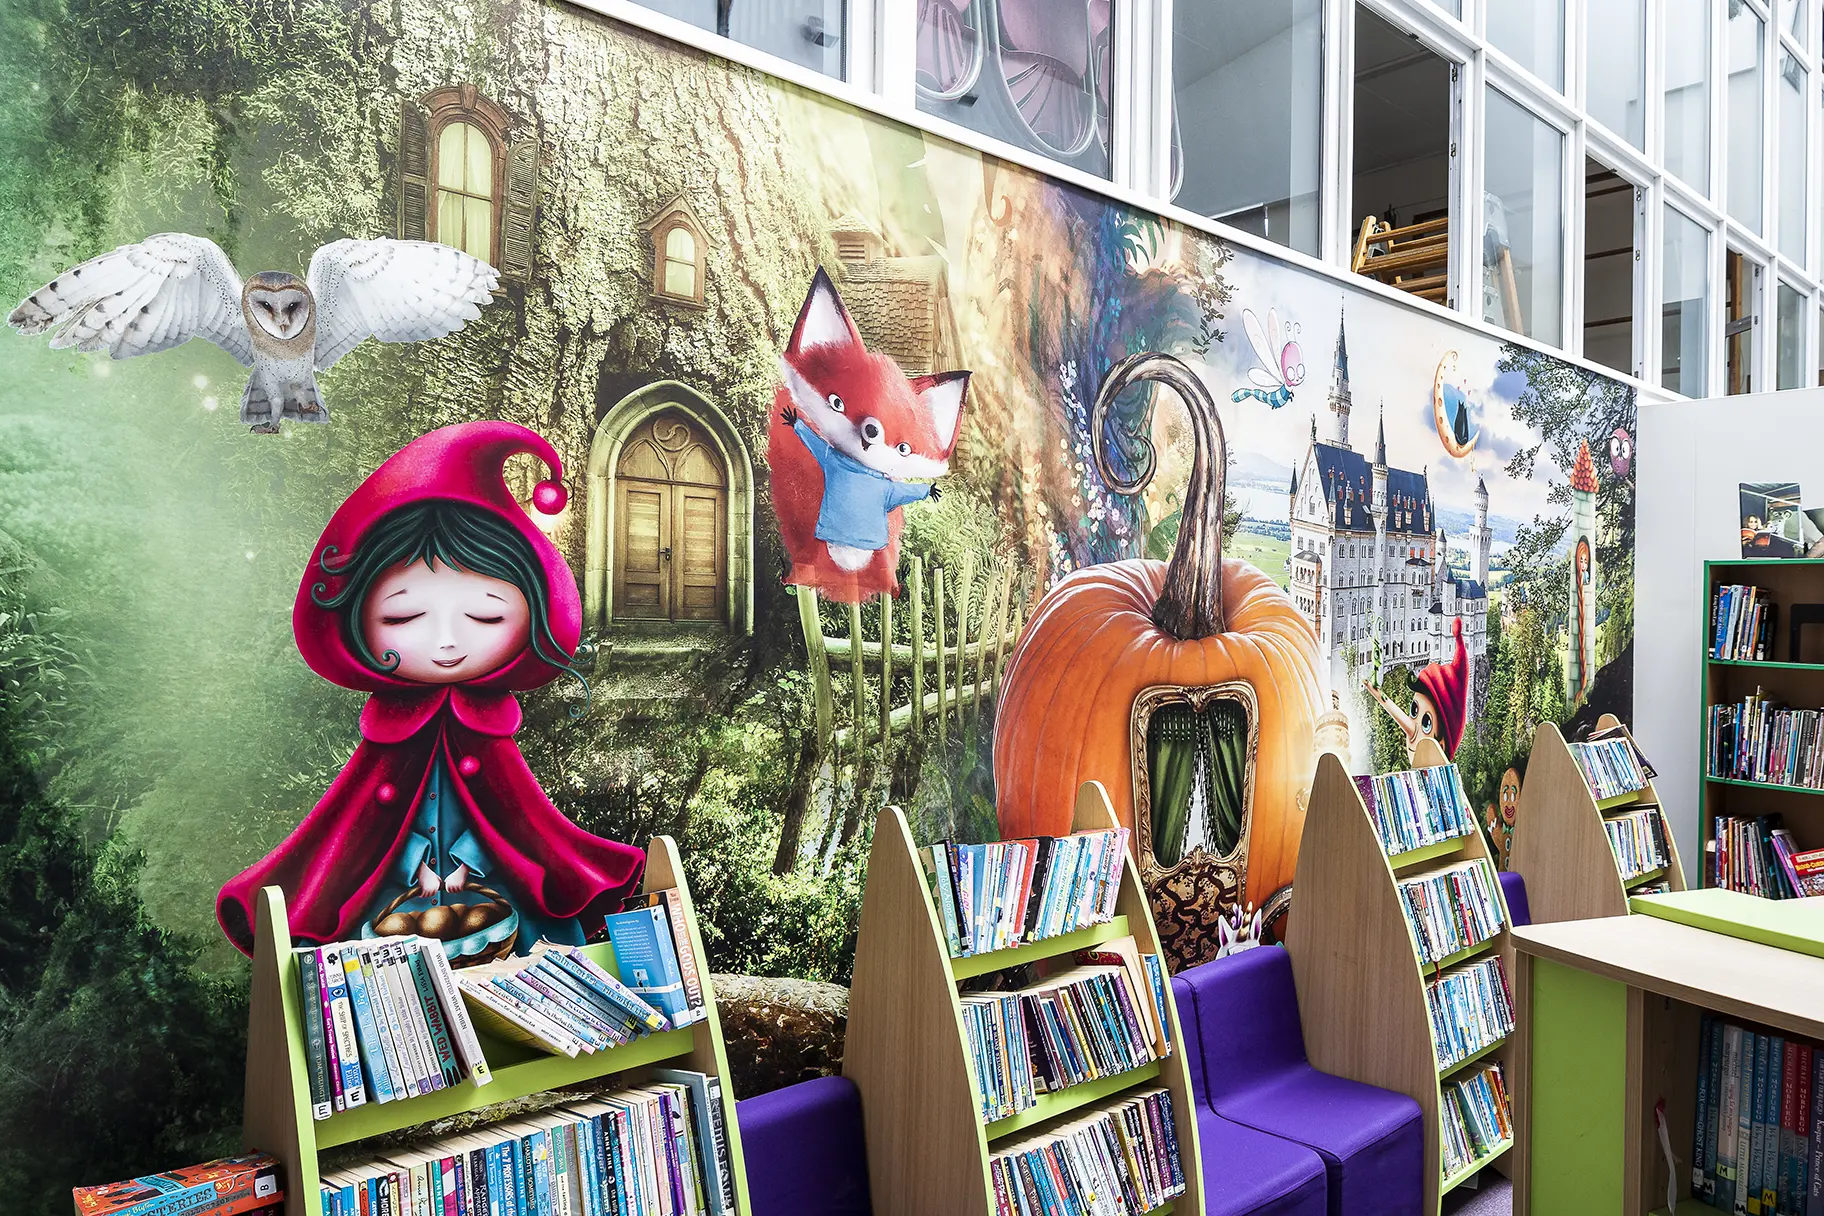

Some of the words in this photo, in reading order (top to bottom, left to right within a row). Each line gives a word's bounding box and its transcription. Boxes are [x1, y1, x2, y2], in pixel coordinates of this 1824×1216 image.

[1102, 849, 1110, 870] Cassidy
[939, 874, 949, 891] Toby
[670, 902, 686, 932] WHO
[943, 892, 952, 917] Alone
[413, 958, 423, 976] EVANS
[678, 944, 696, 977] GODS
[353, 982, 367, 1006] Boy
[419, 975, 428, 992] LISSA
[434, 952, 445, 968] WHO
[440, 967, 455, 995] INVENTED
[449, 994, 461, 1012] WHAT
[456, 1011, 467, 1030] WHEN
[685, 976, 703, 1007] OUT?
[338, 1010, 346, 1023] SHIP
[423, 993, 444, 1035] WABBIT
[341, 1030, 352, 1058] SPECTRES
[424, 1039, 433, 1056] EDWARDS
[436, 1036, 451, 1062] WED
[1722, 1042, 1731, 1076] morpurgo
[1731, 1051, 1739, 1078] michael
[1783, 1045, 1796, 1082] MICHAEL
[1797, 1050, 1809, 1086] MICHAEL
[314, 1069, 328, 1103] EGLINGTO
[344, 1069, 354, 1087] Ellio
[351, 1064, 360, 1086] Patric
[1697, 1087, 1706, 1103] FOX
[1754, 1076, 1764, 1120] MORPURGO
[1768, 1078, 1777, 1122] MORPURGO
[1781, 1082, 1794, 1127] MORPURGO
[1795, 1087, 1808, 1132] MORPURGO
[707, 1097, 728, 1160] RTEMIS
[1695, 1120, 1704, 1145] GHOST
[1814, 1118, 1824, 1144] Kaspar
[500, 1145, 510, 1156] The
[522, 1139, 533, 1175] CHARLOTTE
[1694, 1146, 1703, 1166] KING
[1813, 1150, 1823, 1172] Prince
[515, 1158, 523, 1178] ANNE
[1737, 1162, 1745, 1193] MANFRED
[416, 1174, 425, 1196] Anne
[501, 1163, 516, 1200] PROFESSORS
[517, 1181, 525, 1198] FINE
[525, 1177, 536, 1210] SOMETIMES
[1812, 1181, 1821, 1197] Cats
[379, 1197, 389, 1216] MORE
[417, 1197, 428, 1216] Fran
[560, 1191, 568, 1210] farting
